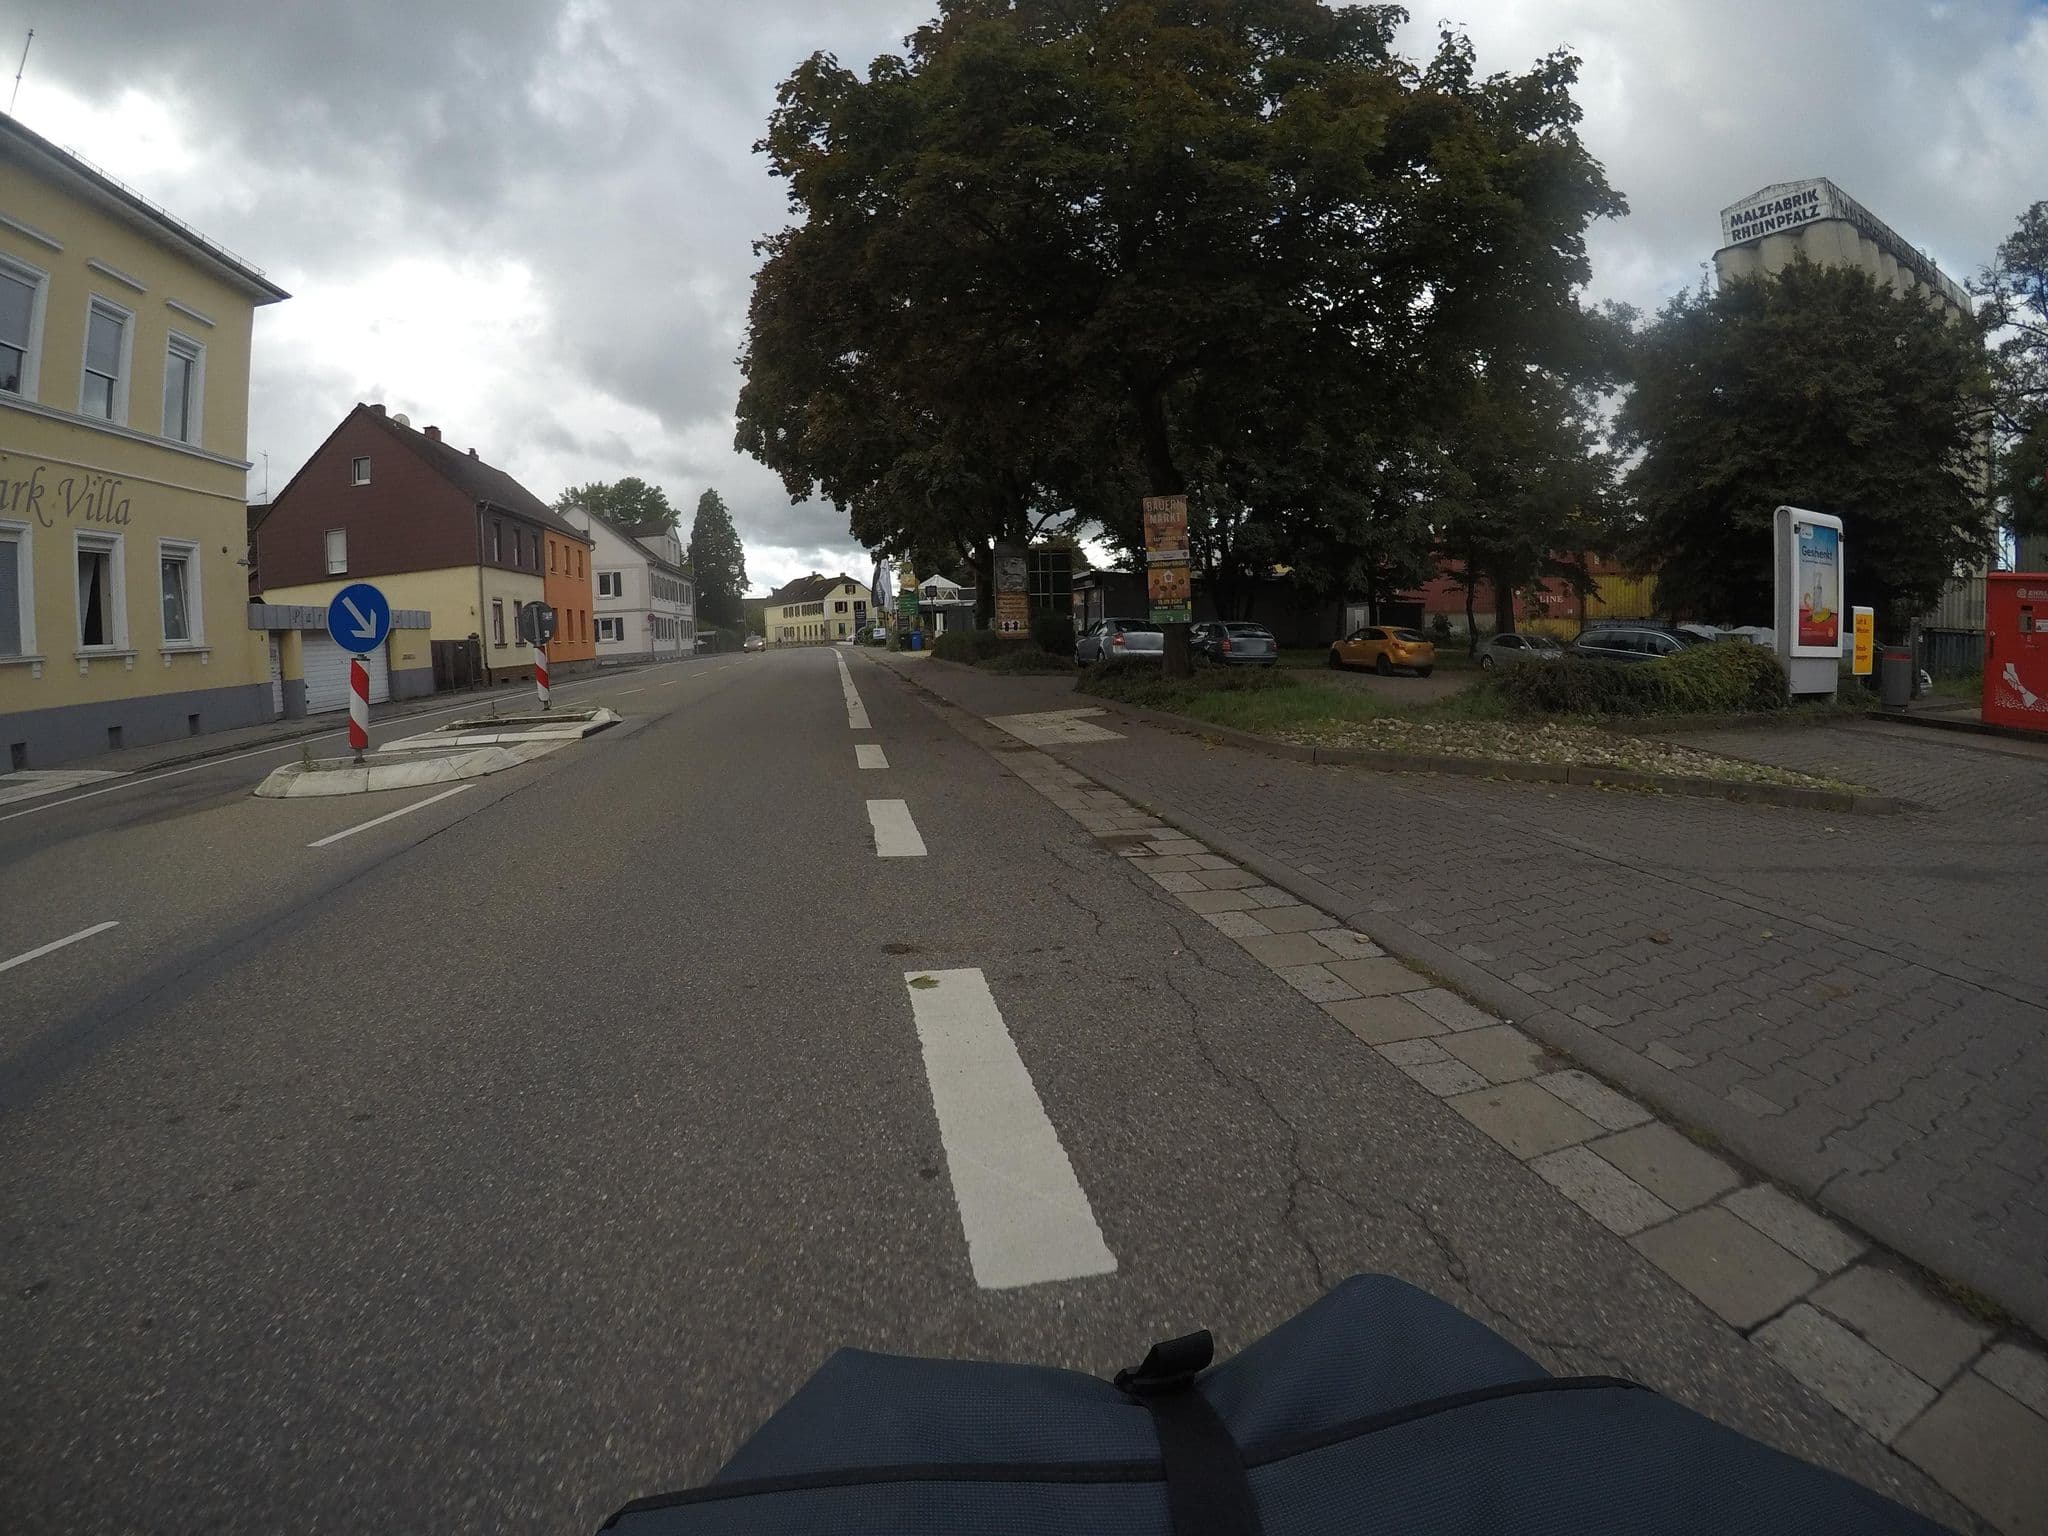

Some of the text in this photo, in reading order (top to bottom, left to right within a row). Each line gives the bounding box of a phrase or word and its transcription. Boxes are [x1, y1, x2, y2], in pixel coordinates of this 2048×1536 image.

[1730, 188, 1819, 228] MALZFABRIK
[1731, 204, 1821, 242] RHEINPFALZ
[0, 465, 132, 528] ark Villa
[1149, 513, 1181, 524] MARKT
[1539, 595, 1564, 603] LINE
